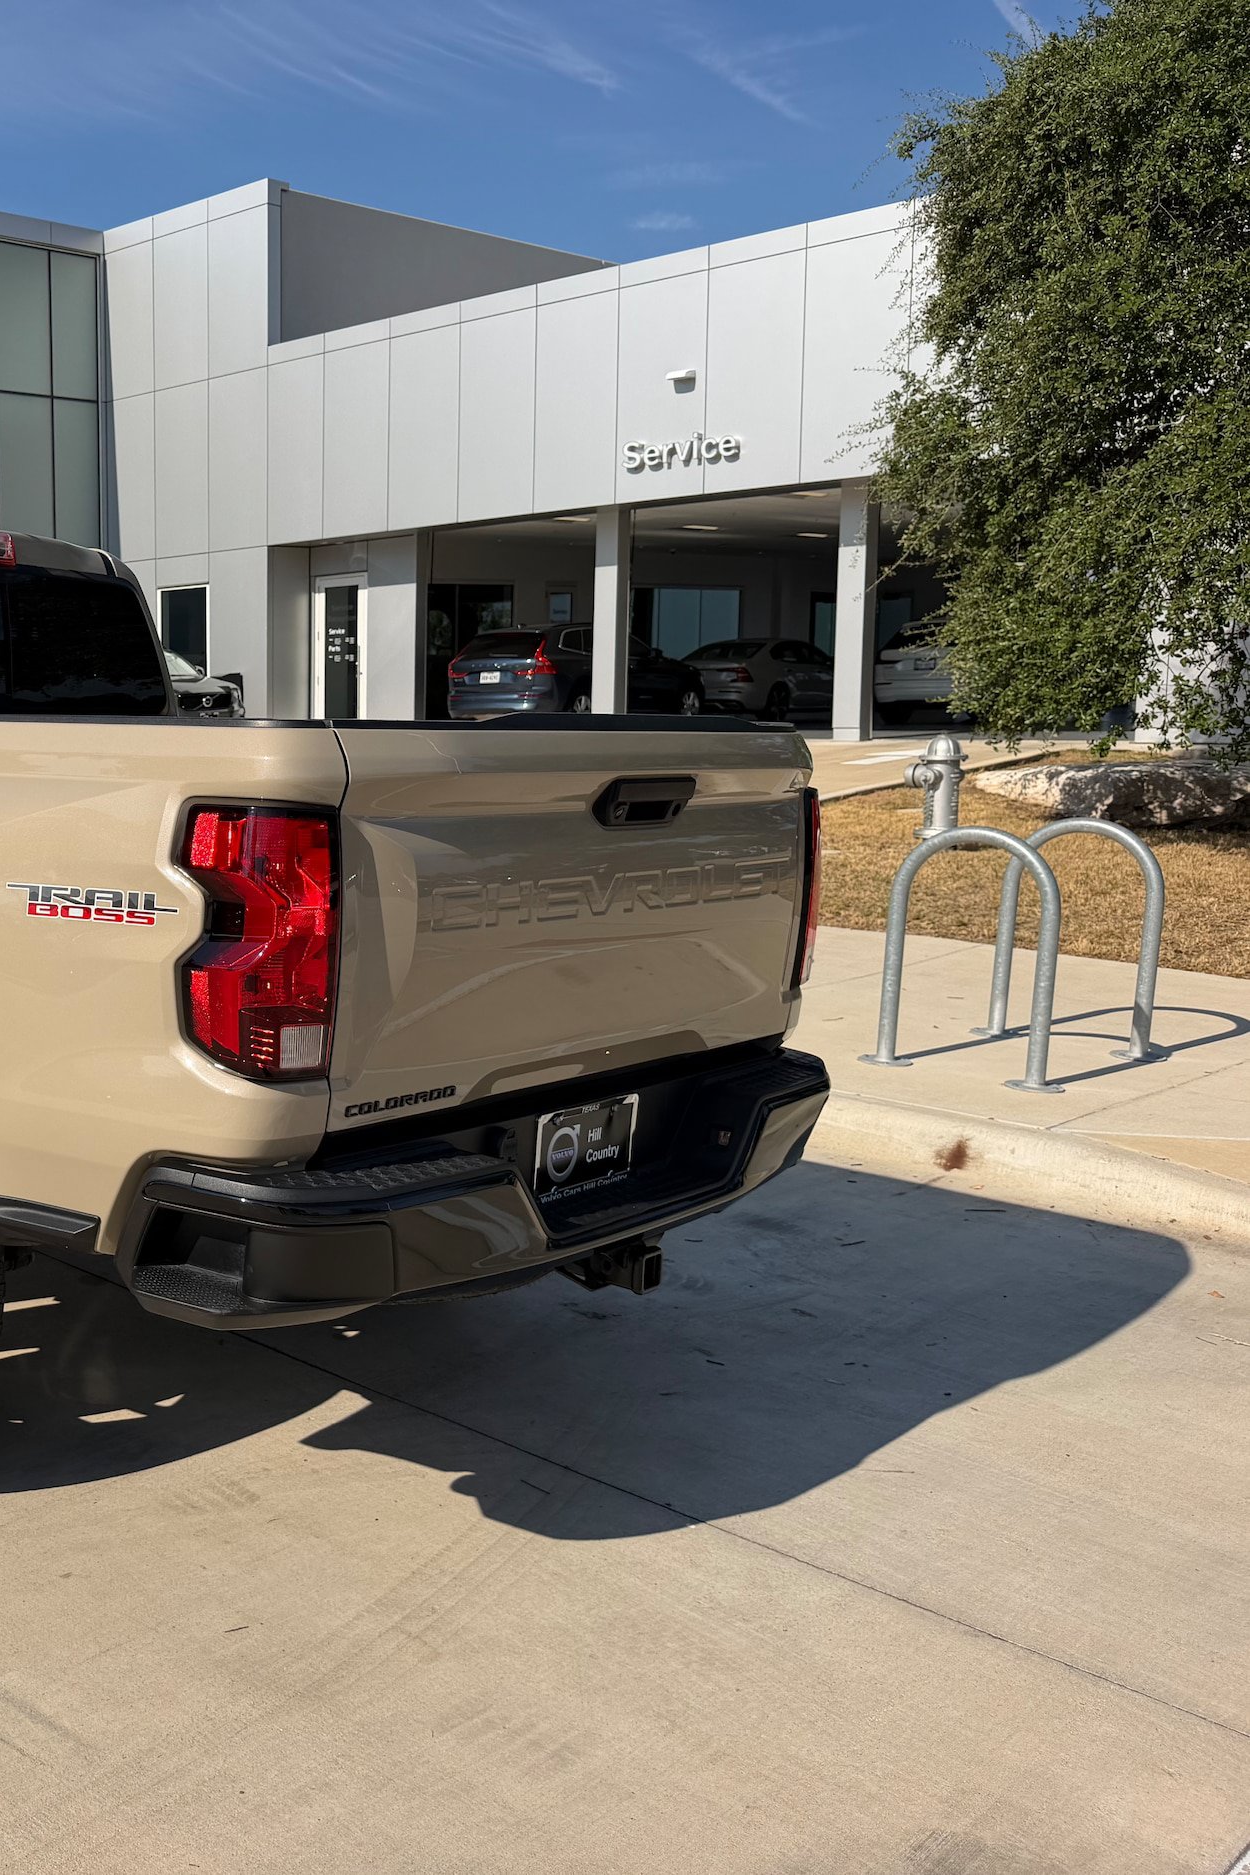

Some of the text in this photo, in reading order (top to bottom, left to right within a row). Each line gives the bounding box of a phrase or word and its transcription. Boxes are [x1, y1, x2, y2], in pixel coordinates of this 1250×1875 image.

[622, 431, 739, 470] Service
[6, 882, 180, 914] TRAIL
[430, 856, 792, 932] CHEVROLET
[26, 902, 157, 926] BOSS
[344, 1084, 458, 1118] COLORADO
[581, 1103, 601, 1114] TEXAS
[587, 1126, 603, 1143] Hill
[551, 1149, 575, 1160] VOLVO
[585, 1144, 620, 1163] Country
